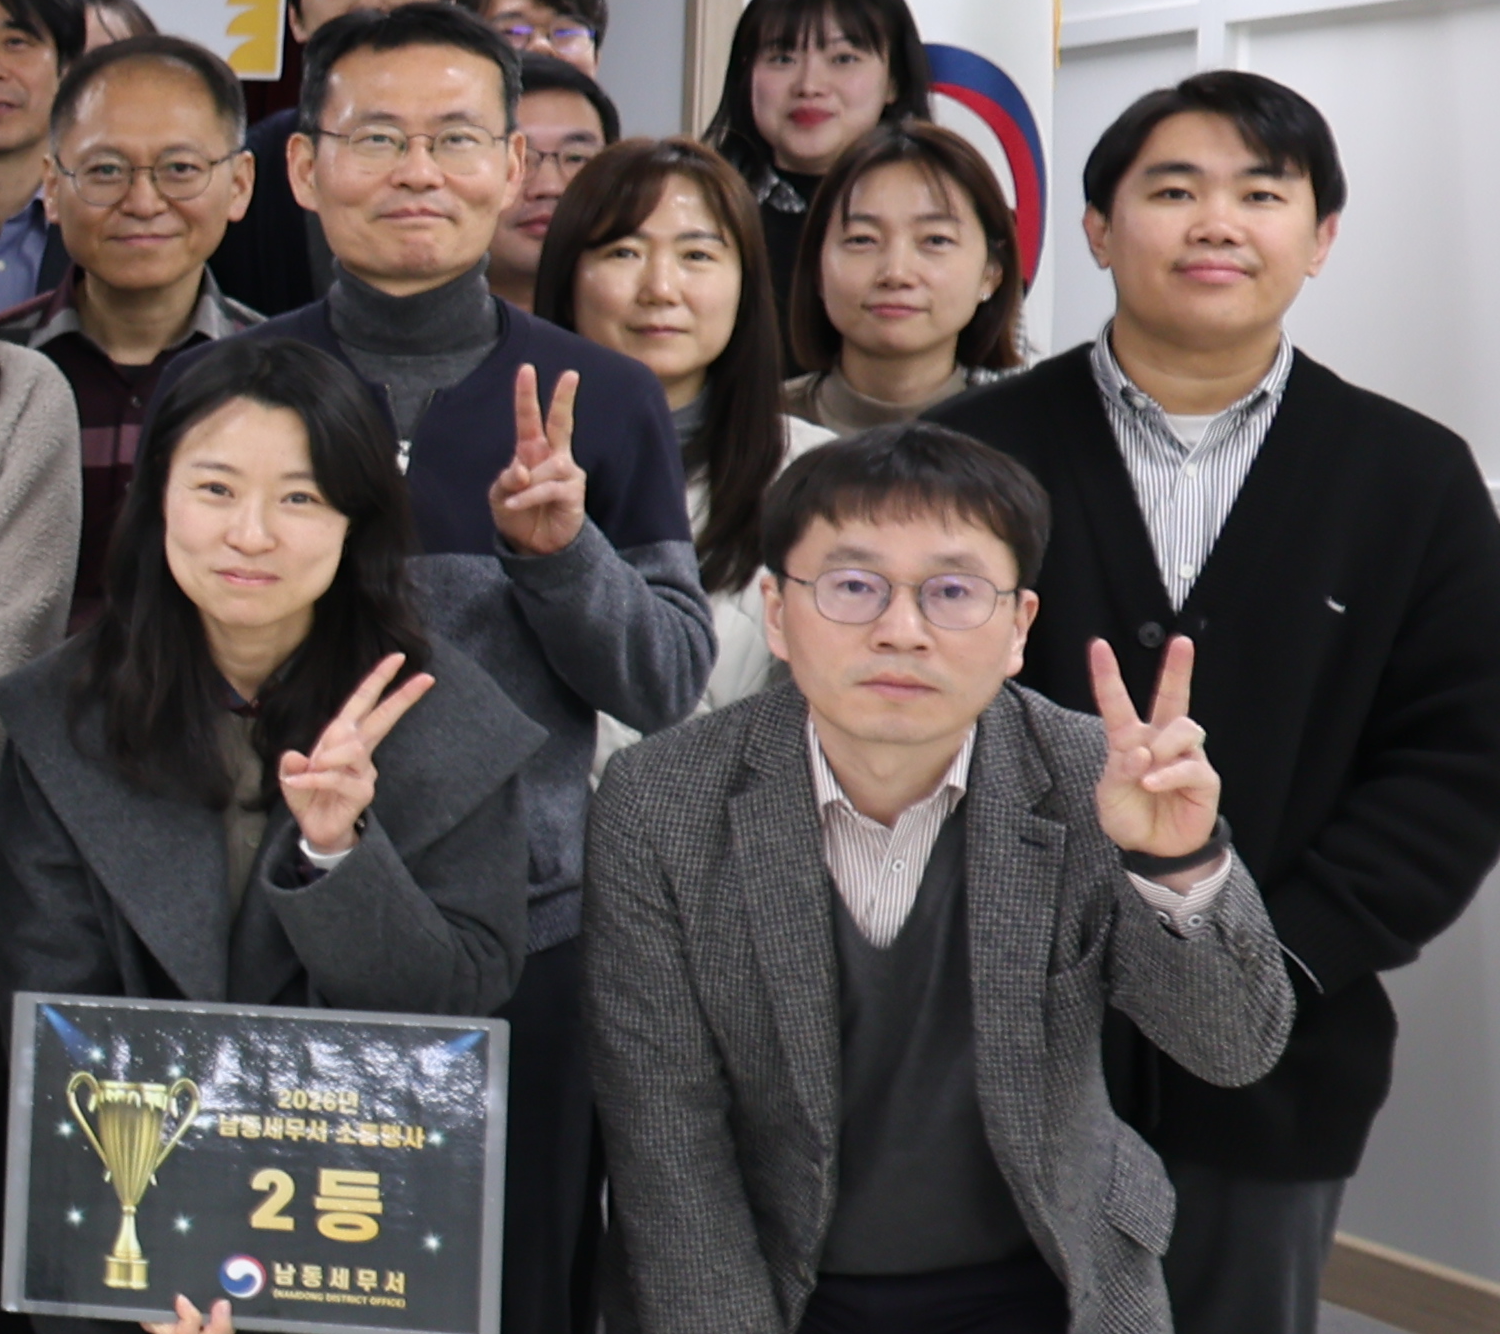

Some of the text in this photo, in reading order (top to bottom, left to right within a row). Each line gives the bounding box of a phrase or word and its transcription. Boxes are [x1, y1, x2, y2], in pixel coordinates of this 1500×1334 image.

[276, 1088, 360, 1115] 2026년
[218, 1113, 426, 1150] 남동세무서 소통행사
[272, 1261, 406, 1295] 남동세무서
